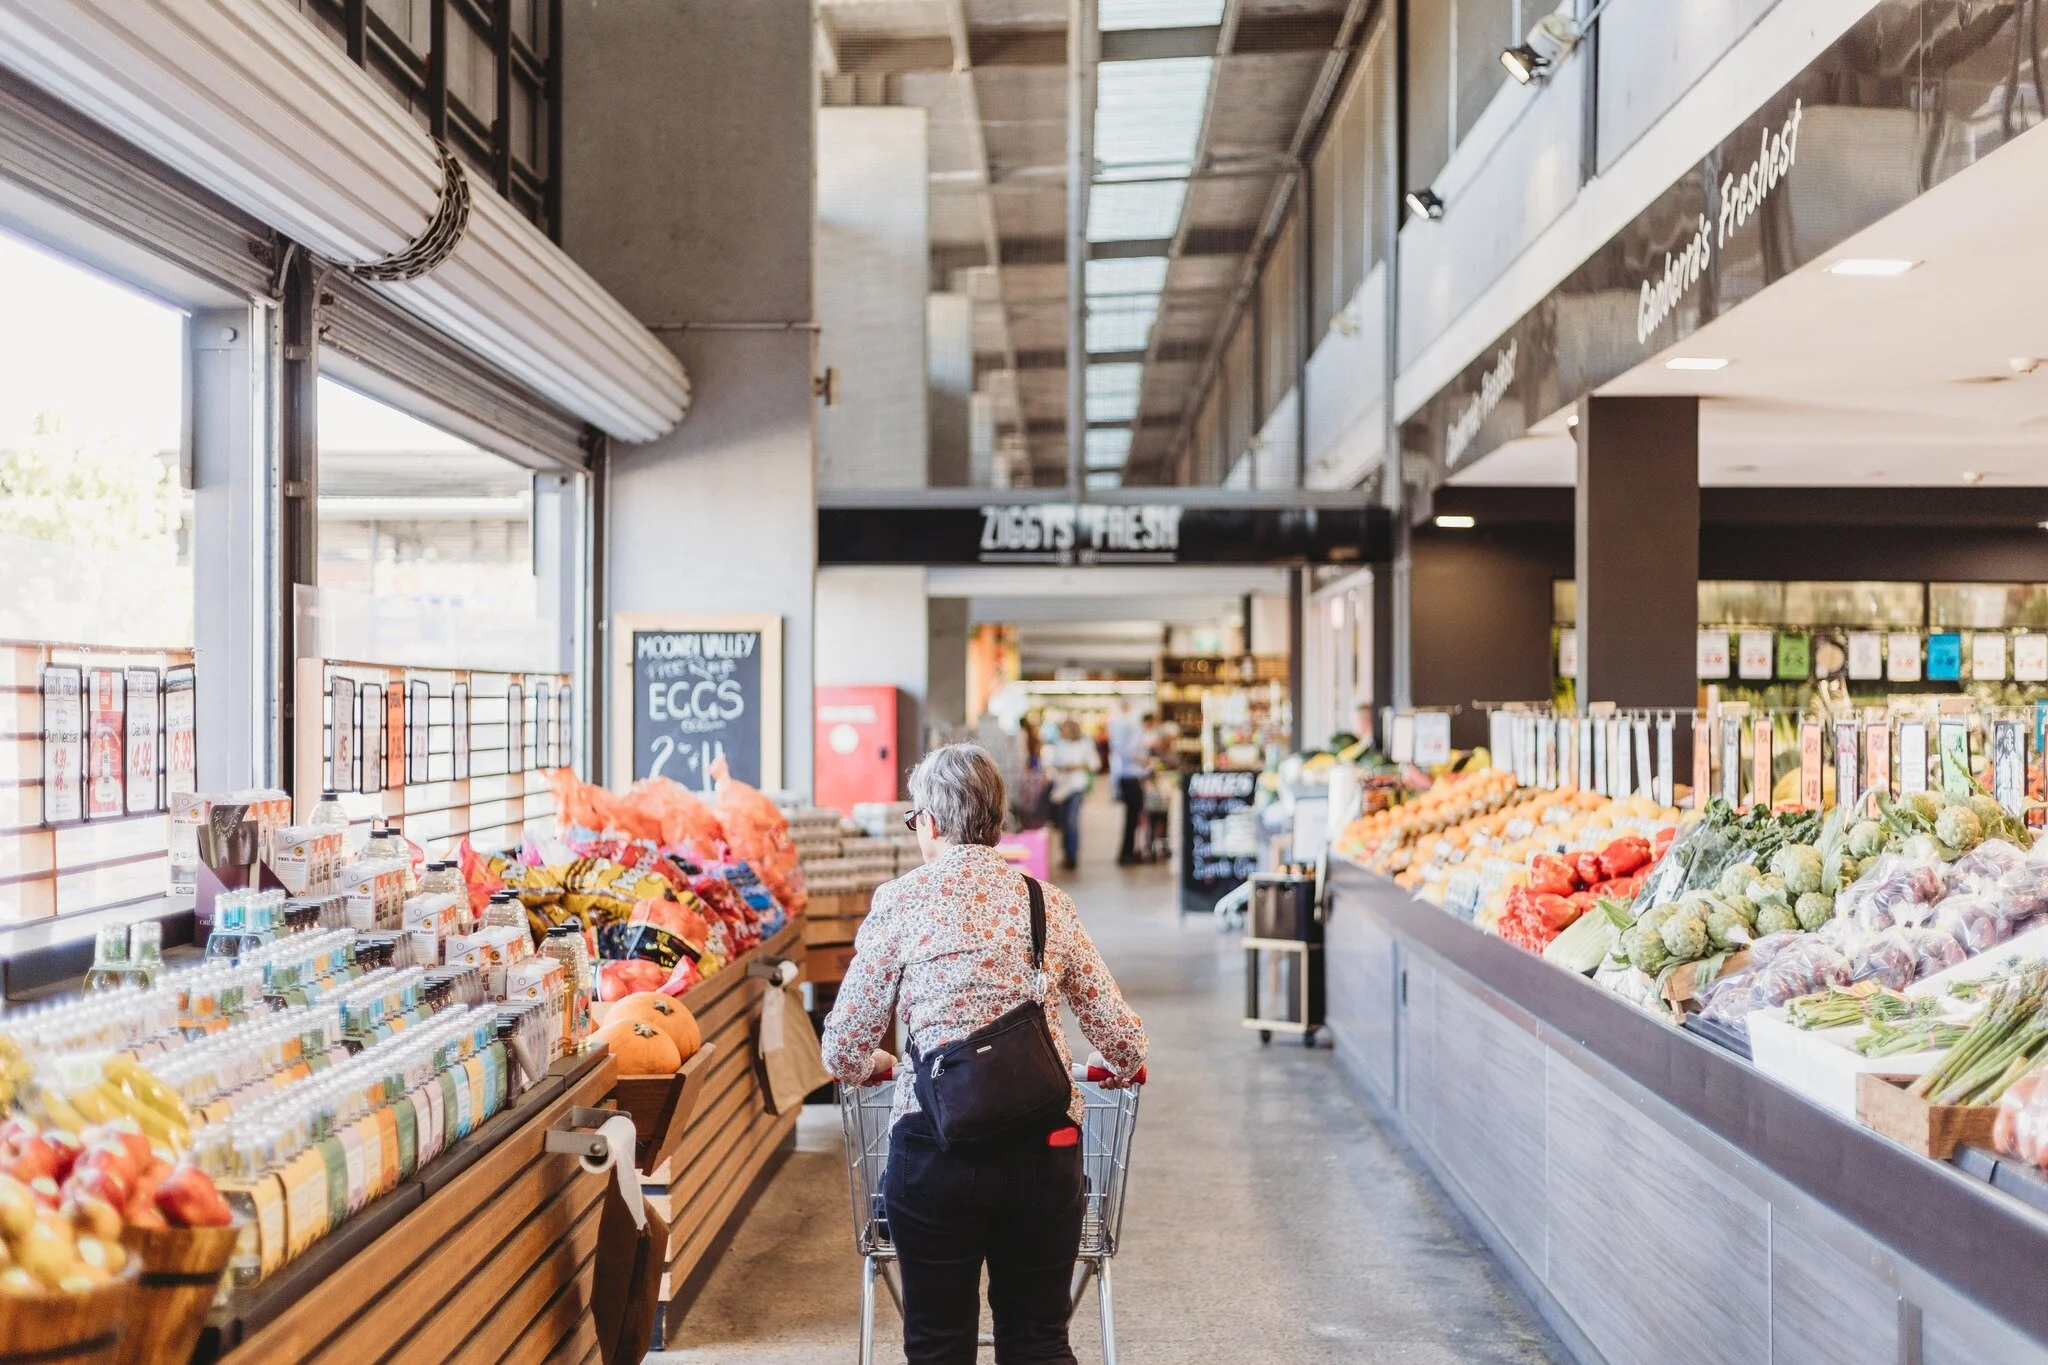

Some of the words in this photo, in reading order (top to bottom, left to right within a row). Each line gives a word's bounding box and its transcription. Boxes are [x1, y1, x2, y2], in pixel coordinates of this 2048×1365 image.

[1718, 97, 1802, 250] Freshest
[1088, 504, 1184, 550] FRESH
[648, 679, 745, 721] EGGS
